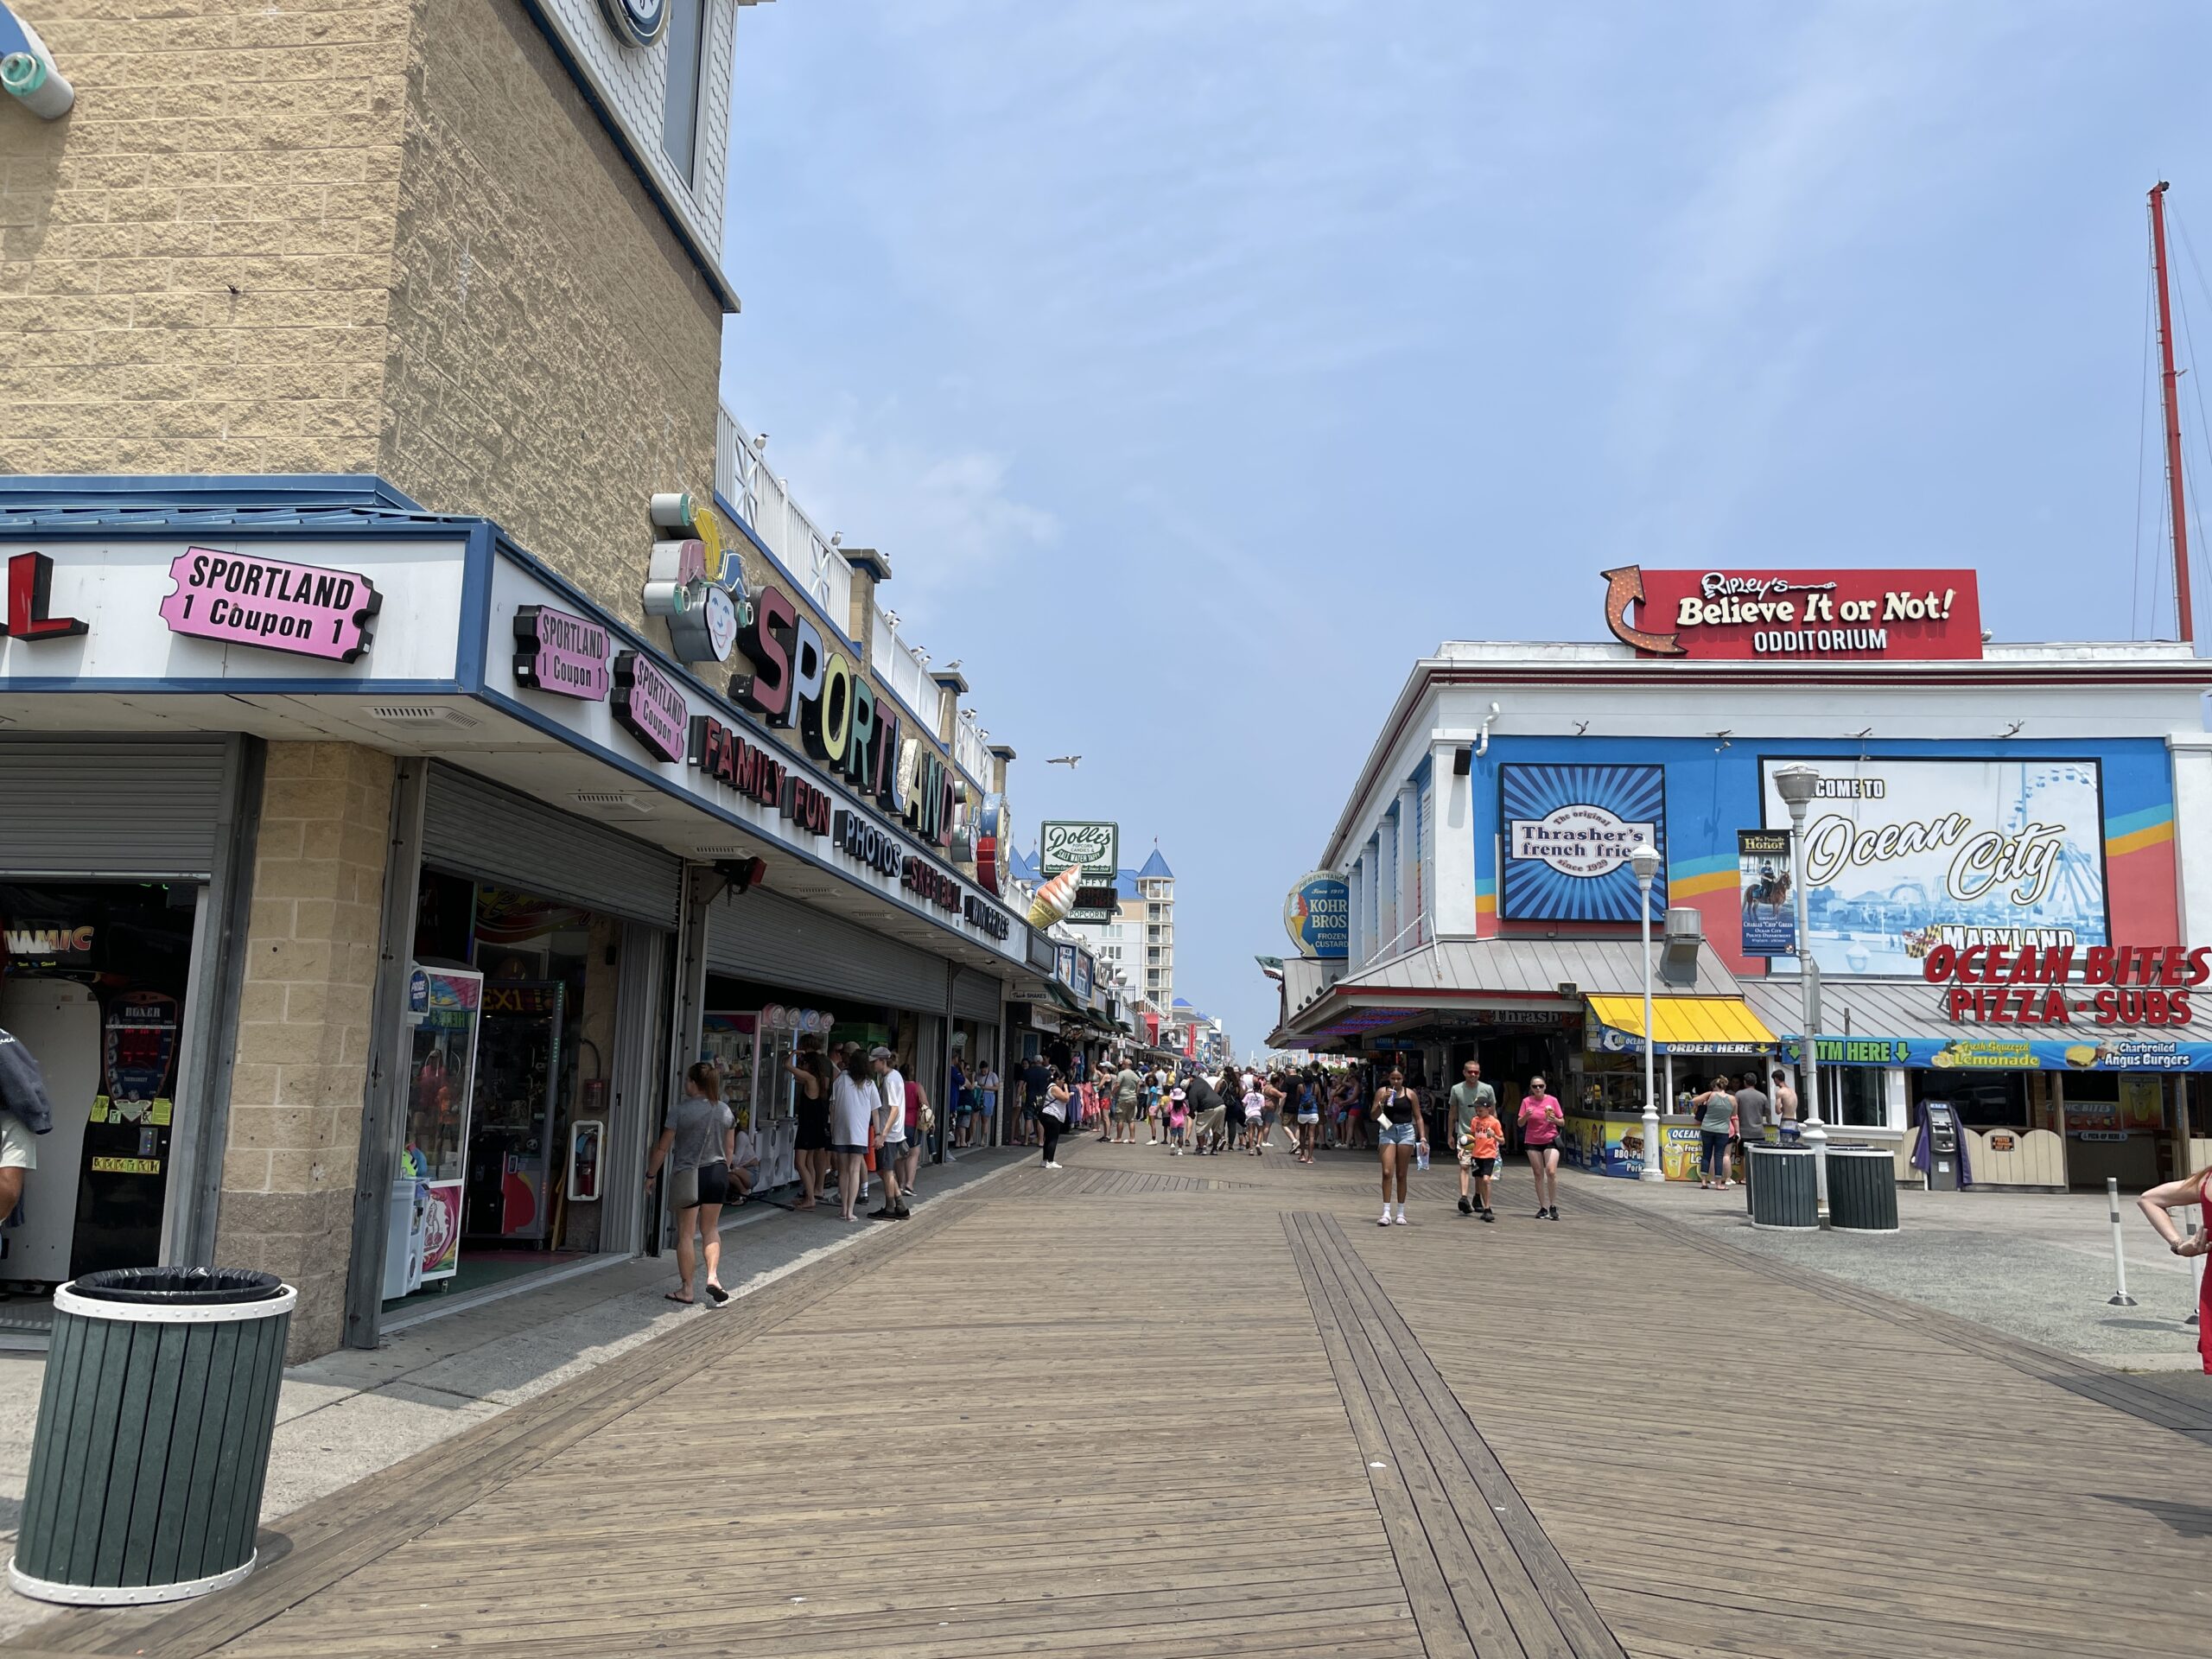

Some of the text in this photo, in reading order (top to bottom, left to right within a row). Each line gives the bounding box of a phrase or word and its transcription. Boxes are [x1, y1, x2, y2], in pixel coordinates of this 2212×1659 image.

[189, 555, 354, 611] SPORTLAND
[1700, 572, 1788, 601] Ripley's
[1677, 588, 1955, 626] Believe It or Not!
[183, 594, 342, 645] 1 Coupon 1
[543, 613, 603, 659] SPORTLAND
[1754, 629, 1887, 652] ODDITORIUM
[543, 652, 601, 689] 1 Coupon 1
[638, 660, 682, 726] SPORTLAND
[635, 691, 680, 752] 1 Coupon 1
[748, 586, 955, 847] SPORTLAND
[702, 716, 830, 836] FAMILY FUN
[1865, 779, 1885, 798] TO
[1554, 810, 1611, 827] The original
[844, 810, 901, 877] PHOTOS
[1046, 827, 1110, 851] Dolle's
[1522, 826, 1643, 842] Thrasher's
[1745, 838, 1785, 849] Honor
[1057, 850, 1101, 862] SALT WATER TAFFY
[1522, 842, 1632, 857] french frie
[1804, 812, 1970, 885] Ocean
[1557, 860, 1584, 872] since
[1948, 823, 2066, 905] City
[1300, 877, 1313, 888] PIER
[1310, 899, 1348, 912] KOHR
[1941, 925, 2075, 950] MARYLAND
[1924, 944, 2212, 986] OCEAN BITES
[1949, 988, 2192, 1025] PIZZA SUBS
[1667, 1043, 1752, 1053] ORDER HERE
[1847, 1041, 1891, 1062] HERE
[1962, 1040, 2029, 1052] Fresh Squeezed
[2120, 1042, 2175, 1053] Charbroiled
[1955, 1053, 2039, 1066] Lemonade
[2105, 1053, 2190, 1068] Angus Burgers
